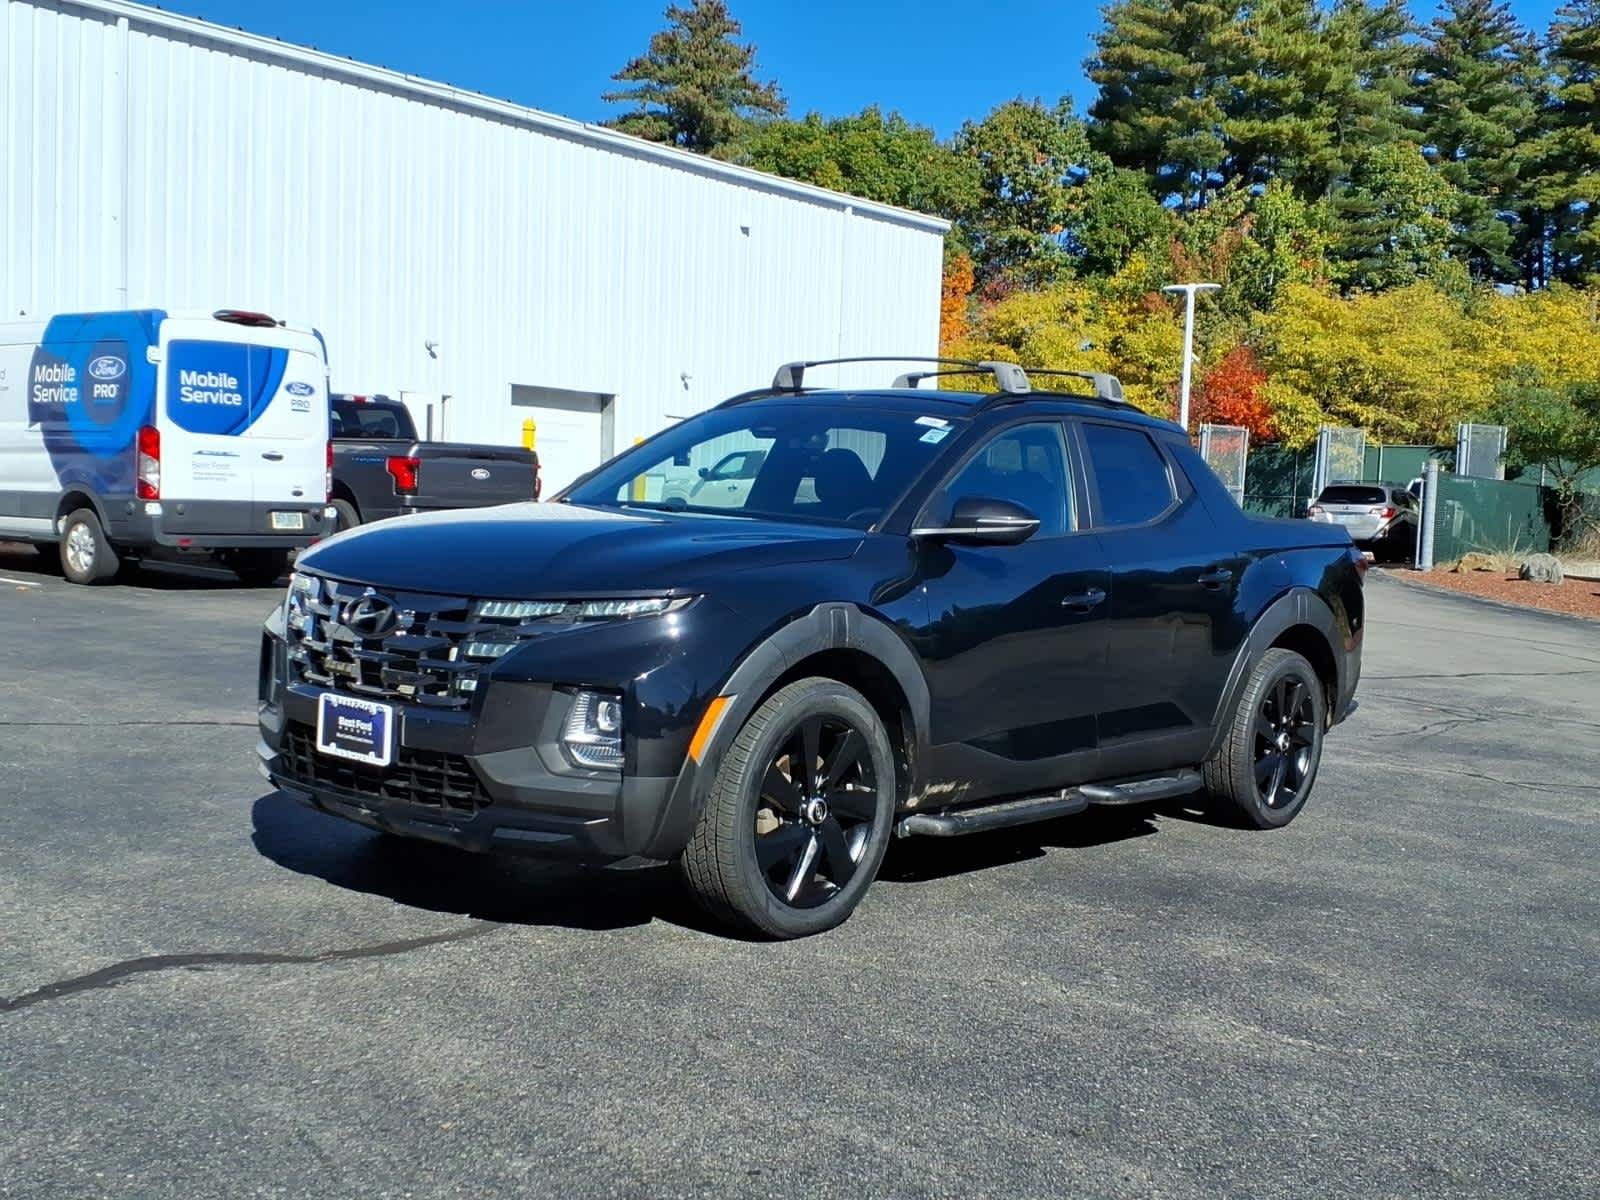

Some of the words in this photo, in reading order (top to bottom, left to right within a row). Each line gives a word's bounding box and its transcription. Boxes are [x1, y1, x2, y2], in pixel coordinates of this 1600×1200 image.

[34, 363, 76, 382] Mobile
[94, 358, 121, 377] Ford
[180, 369, 238, 389] Mobile
[32, 384, 78, 402] Service
[180, 387, 242, 406] Service
[291, 399, 311, 409] PRO
